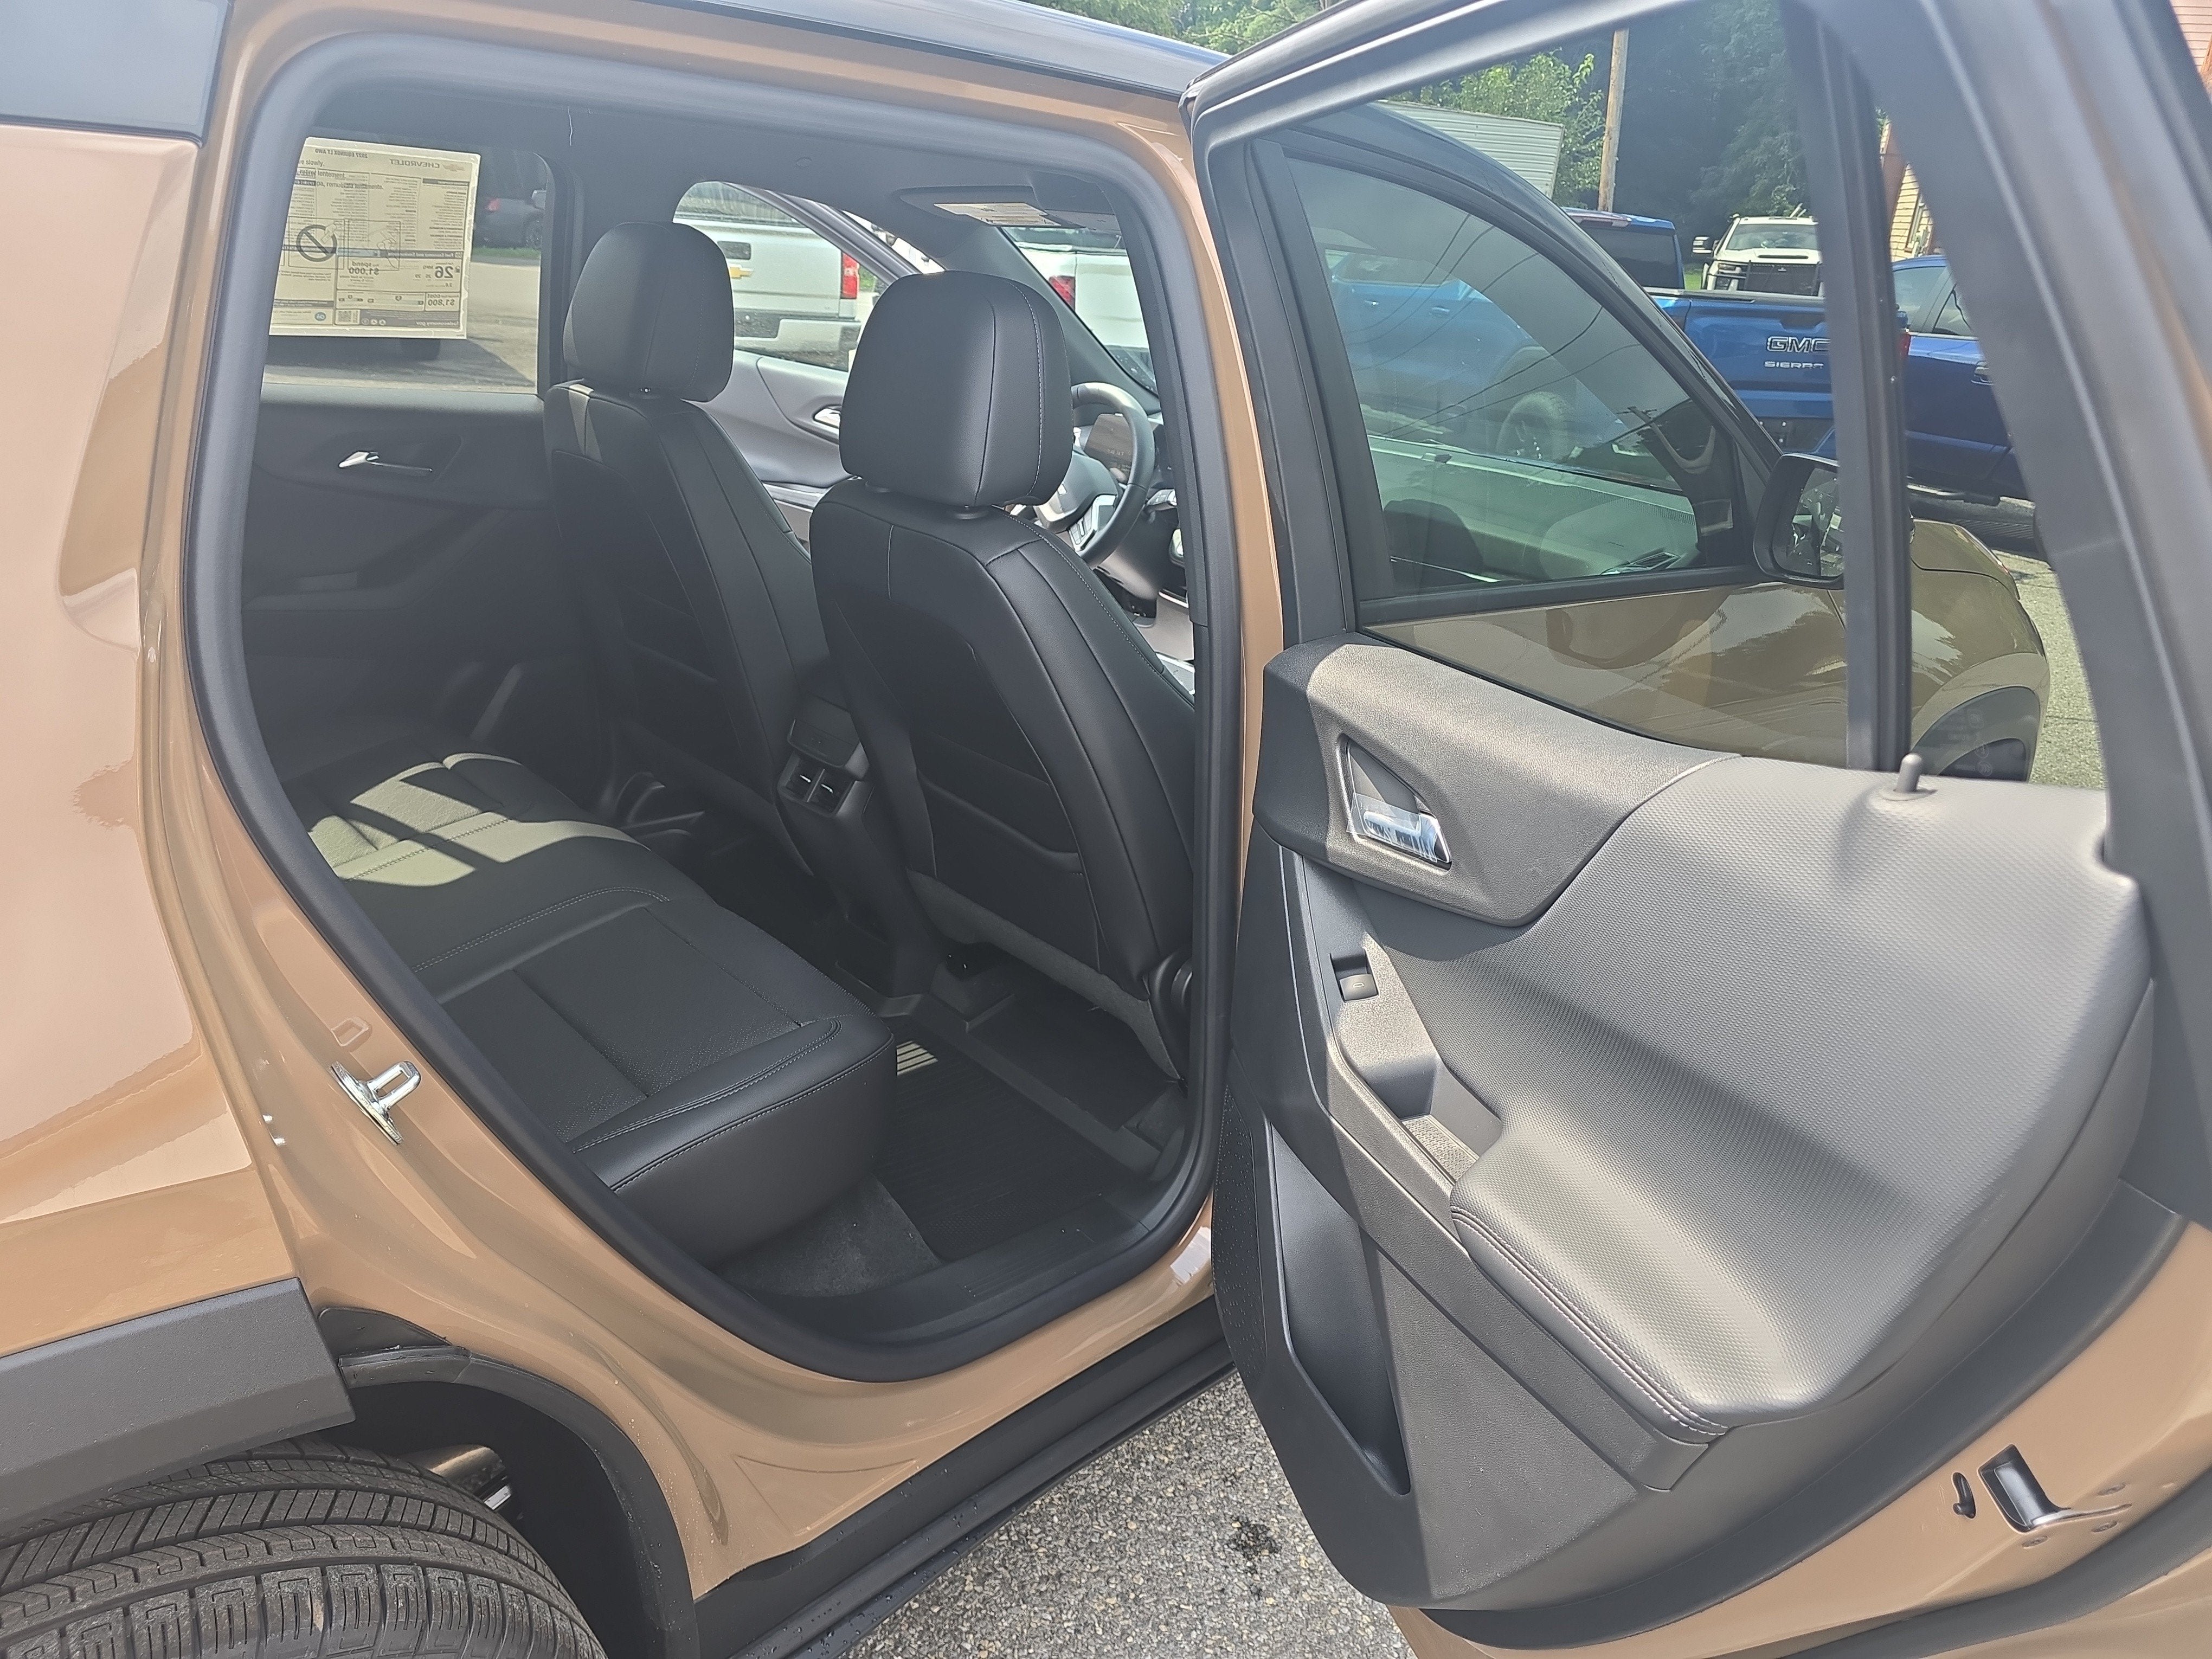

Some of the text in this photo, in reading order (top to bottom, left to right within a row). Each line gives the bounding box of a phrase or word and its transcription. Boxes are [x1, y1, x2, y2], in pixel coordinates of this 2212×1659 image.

[306, 158, 325, 167] slowly.
[1767, 336, 1830, 353] GMC
[1764, 360, 1824, 369] SIERRA
